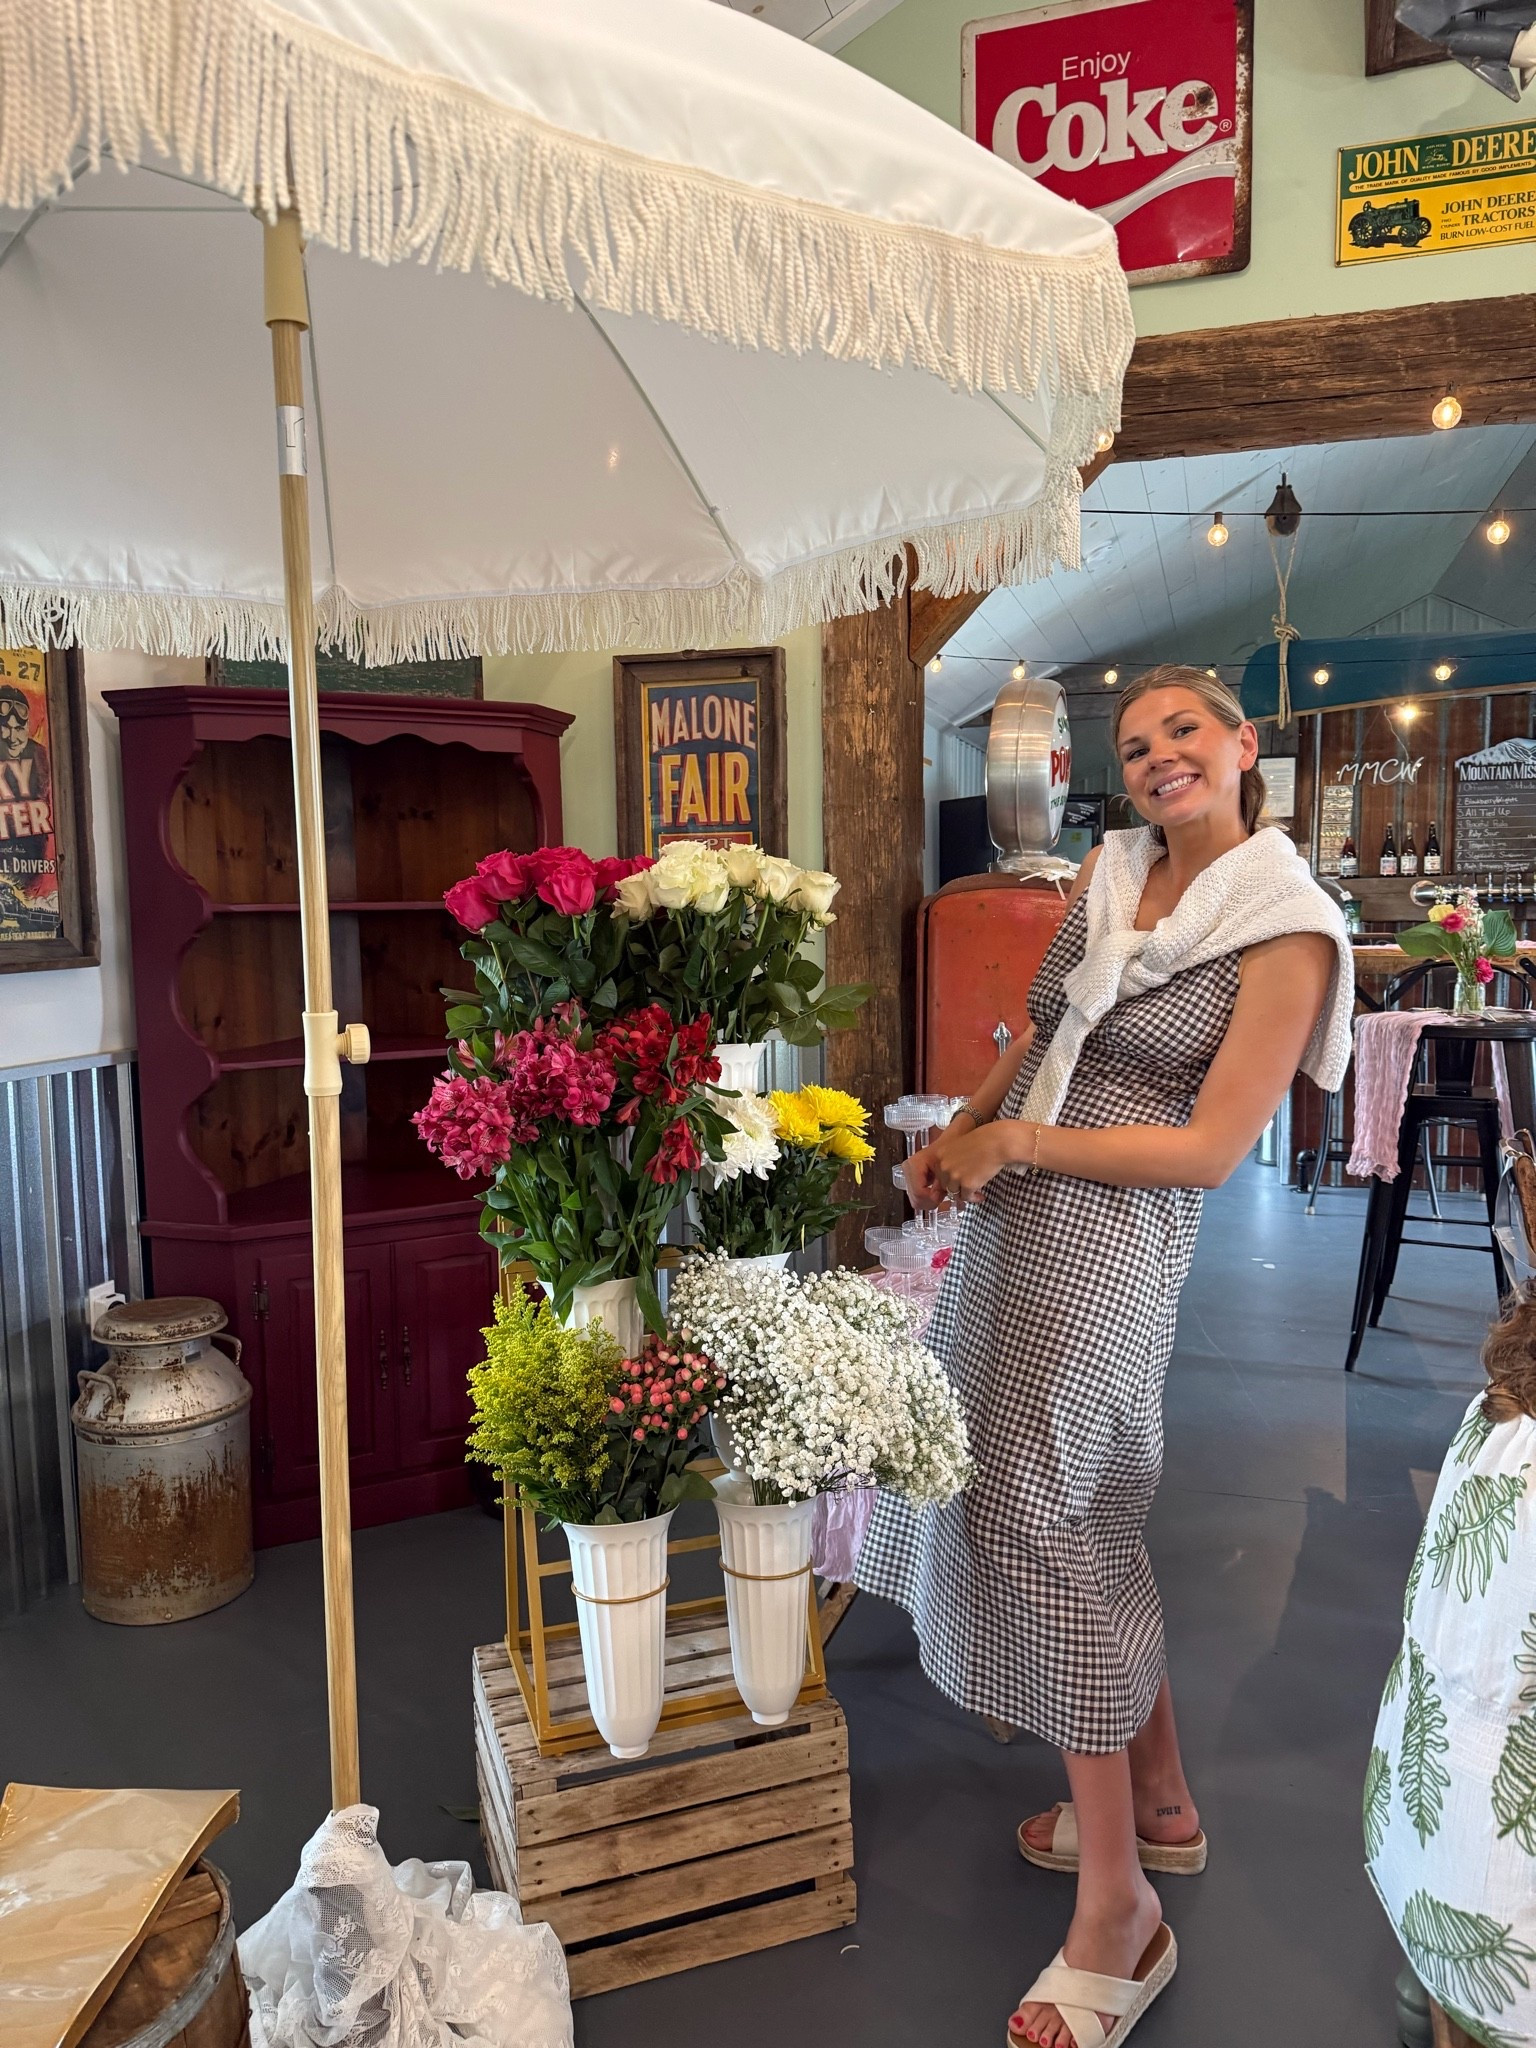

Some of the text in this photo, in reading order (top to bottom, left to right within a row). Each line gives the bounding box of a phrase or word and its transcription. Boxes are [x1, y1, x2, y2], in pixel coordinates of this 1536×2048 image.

[1061, 51, 1132, 81] Enjoy
[992, 77, 1219, 180] Coke
[1348, 127, 1536, 181] JOHN DEERE
[1366, 181, 1383, 189] TRADE
[1384, 179, 1399, 187] MARK
[1409, 174, 1432, 183] QUALITY
[1448, 168, 1471, 177] FAMOUS
[1480, 165, 1498, 173] GOOD
[1498, 160, 1533, 170] IMPLEMENTS
[1441, 190, 1536, 215] JOHN DEERE
[1461, 205, 1536, 226] TRACTORS
[1440, 230, 1465, 241] BURN
[1514, 220, 1536, 231] FUEL
[18, 660, 41, 682] 27
[650, 694, 756, 752] MALONE
[1337, 756, 1425, 786] MMCW
[1460, 764, 1512, 781] MOUNTAIN
[658, 751, 752, 827] FAIR
[1465, 808, 1477, 817] All
[1480, 808, 1496, 817] Tied
[1498, 807, 1511, 816] Up
[12, 856, 56, 875] DRIVERS
